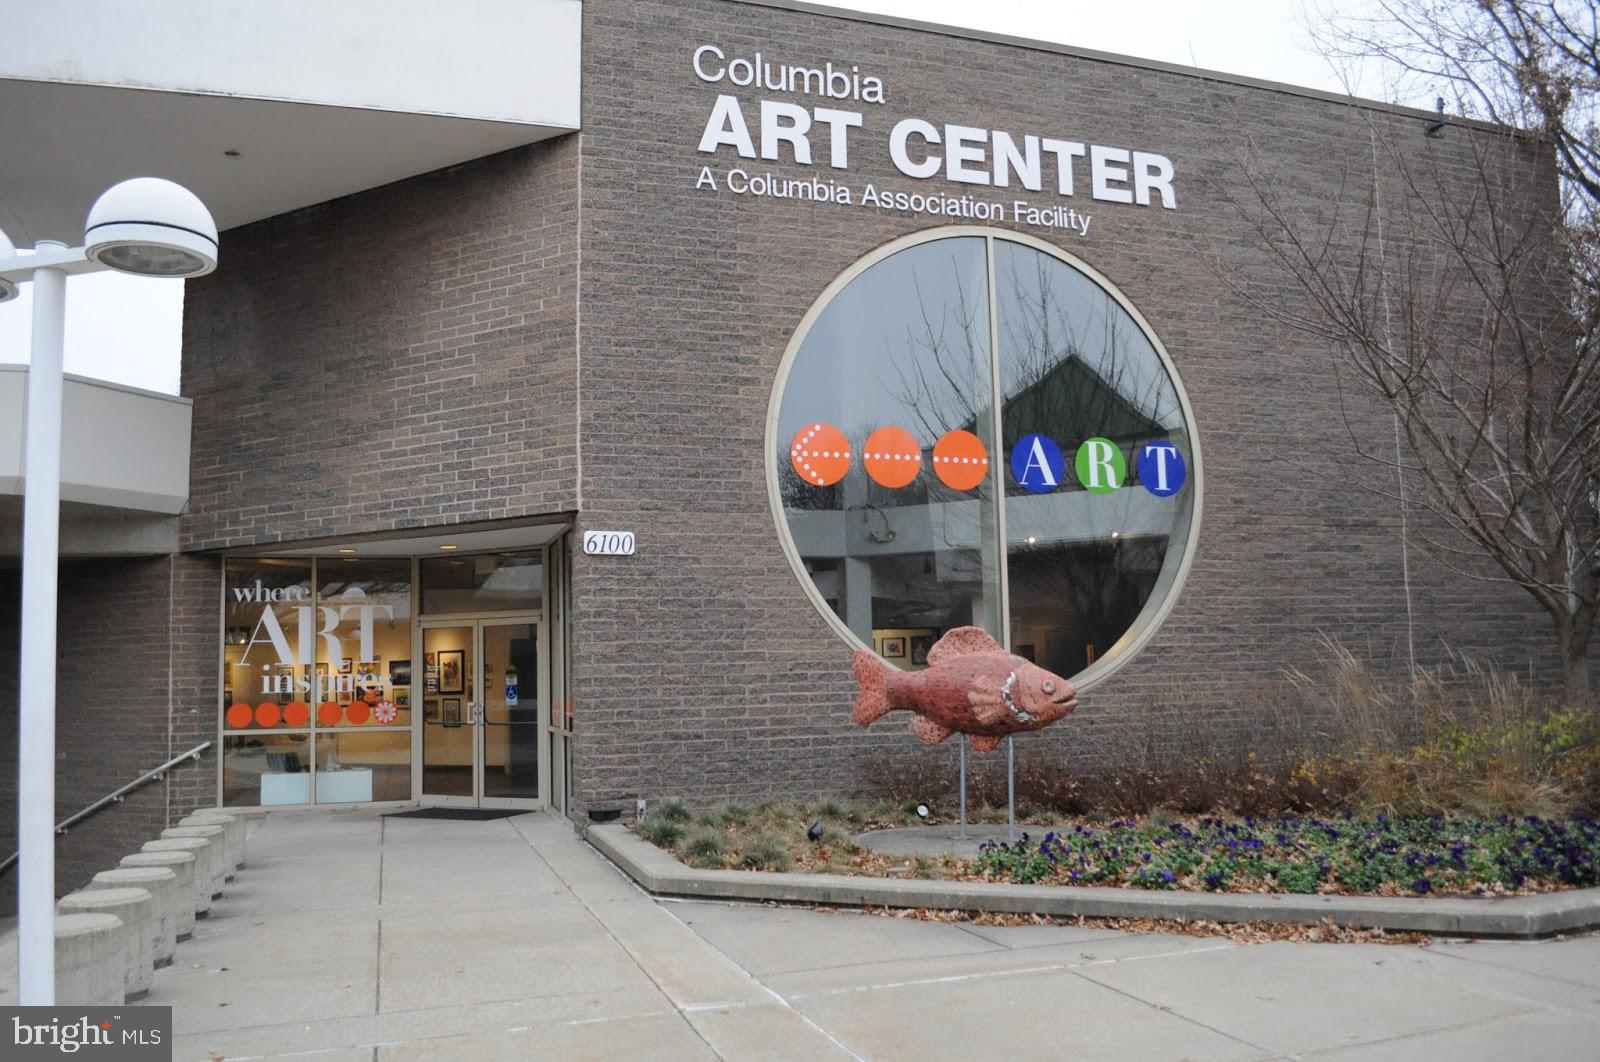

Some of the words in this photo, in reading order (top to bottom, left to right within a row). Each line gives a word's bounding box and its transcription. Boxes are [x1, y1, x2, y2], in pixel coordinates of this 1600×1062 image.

[693, 45, 885, 104] Columbia
[697, 94, 863, 170] ART
[889, 118, 1177, 210] CENTER
[696, 167, 716, 191] A
[727, 170, 851, 206] Columbia
[861, 184, 1003, 222] Association
[1014, 201, 1092, 236] Facility
[1019, 436, 1176, 491] ART
[586, 534, 633, 553] 6100
[233, 579, 310, 603] where
[233, 604, 394, 669] ART
